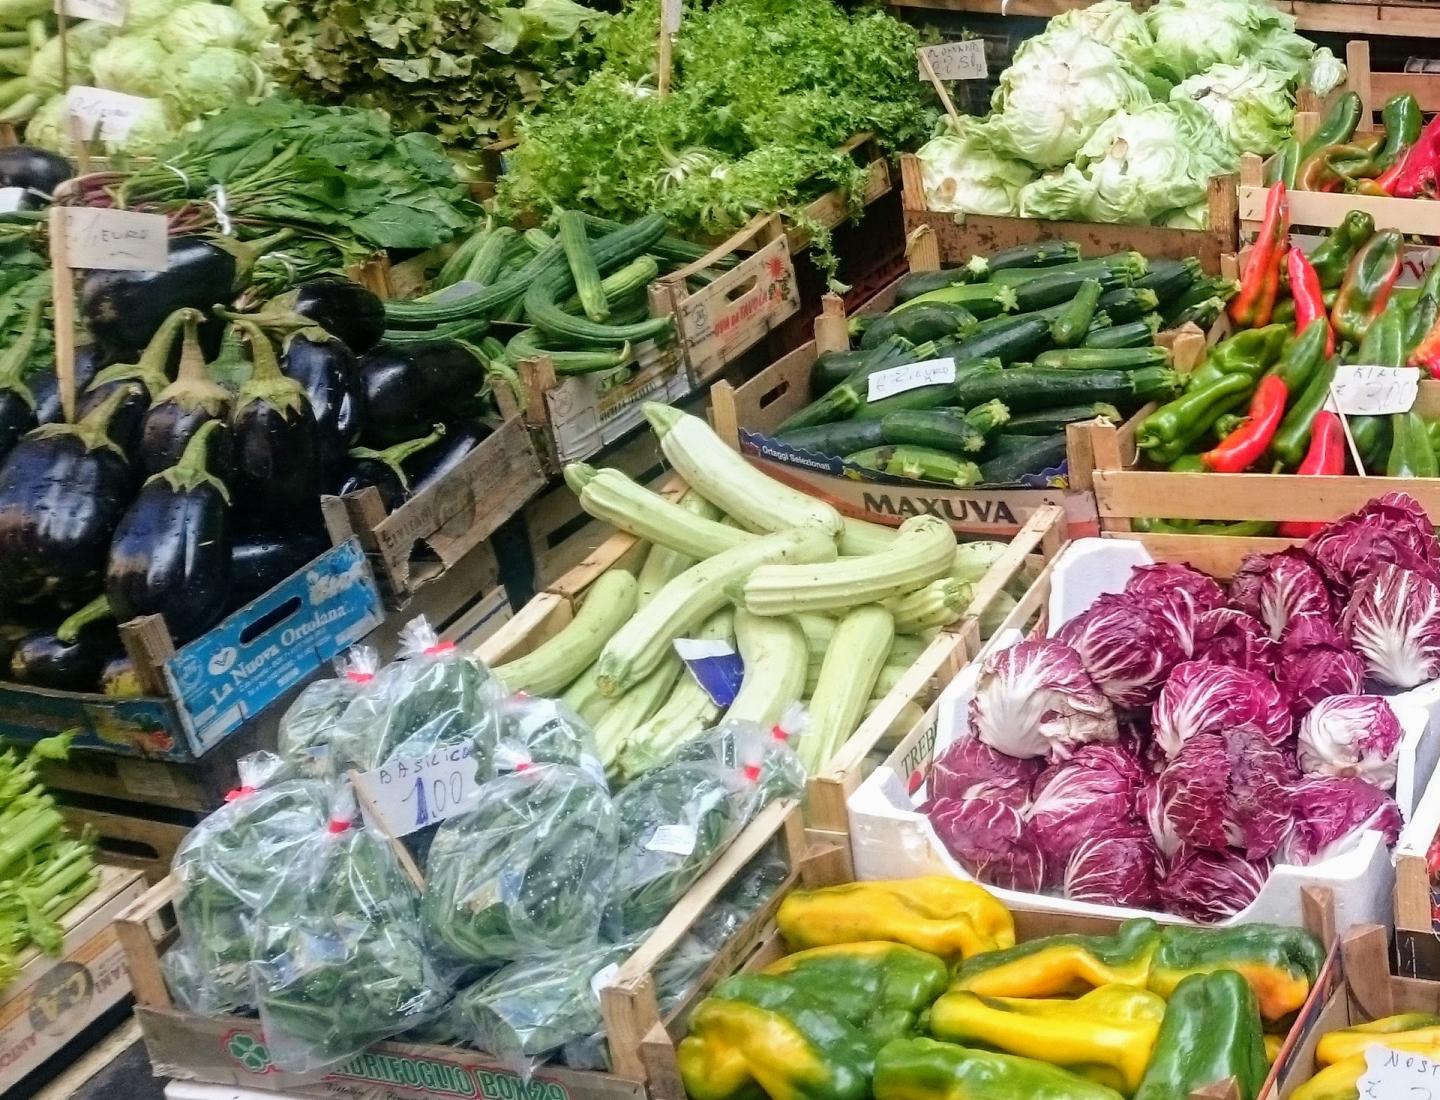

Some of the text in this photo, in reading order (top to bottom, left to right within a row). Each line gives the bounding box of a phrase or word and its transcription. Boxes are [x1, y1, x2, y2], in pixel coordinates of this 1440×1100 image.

[762, 445, 831, 471] Ortaggi Selezionati
[862, 491, 1018, 525] MAXUVA
[209, 683, 234, 705] La
[230, 644, 280, 685] Nuova
[379, 746, 470, 785] BASILICO
[901, 718, 939, 779] TREB
